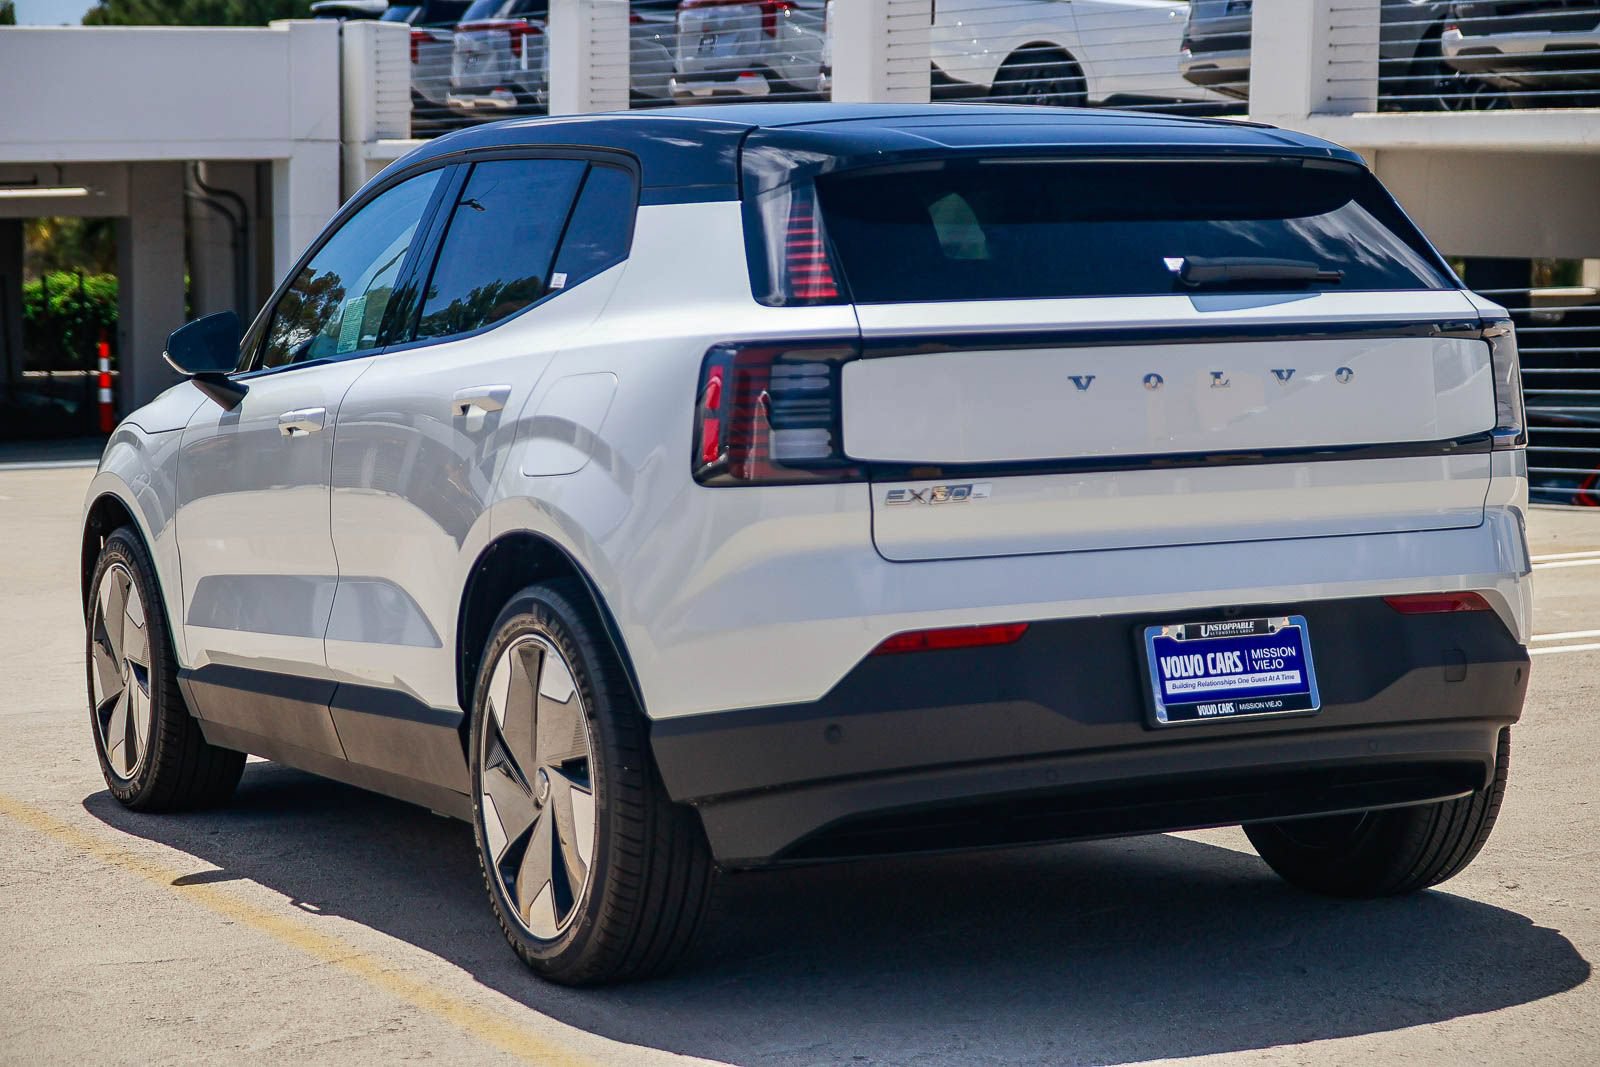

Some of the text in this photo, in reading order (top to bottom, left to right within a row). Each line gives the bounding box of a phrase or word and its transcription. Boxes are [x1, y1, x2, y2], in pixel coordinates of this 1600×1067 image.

[1066, 366, 1356, 391] VOLVO
[1201, 622, 1254, 637] UNSTOPPABLE
[1251, 647, 1296, 659] MISSION
[1161, 651, 1243, 678] VOLVO CARS
[1253, 659, 1284, 670] VIEJO
[1172, 682, 1196, 690] Building
[1197, 679, 1236, 688] Relationships
[1197, 704, 1217, 715] VOLVO
[1218, 702, 1235, 713] CARS
[1239, 702, 1264, 710] MISSION
